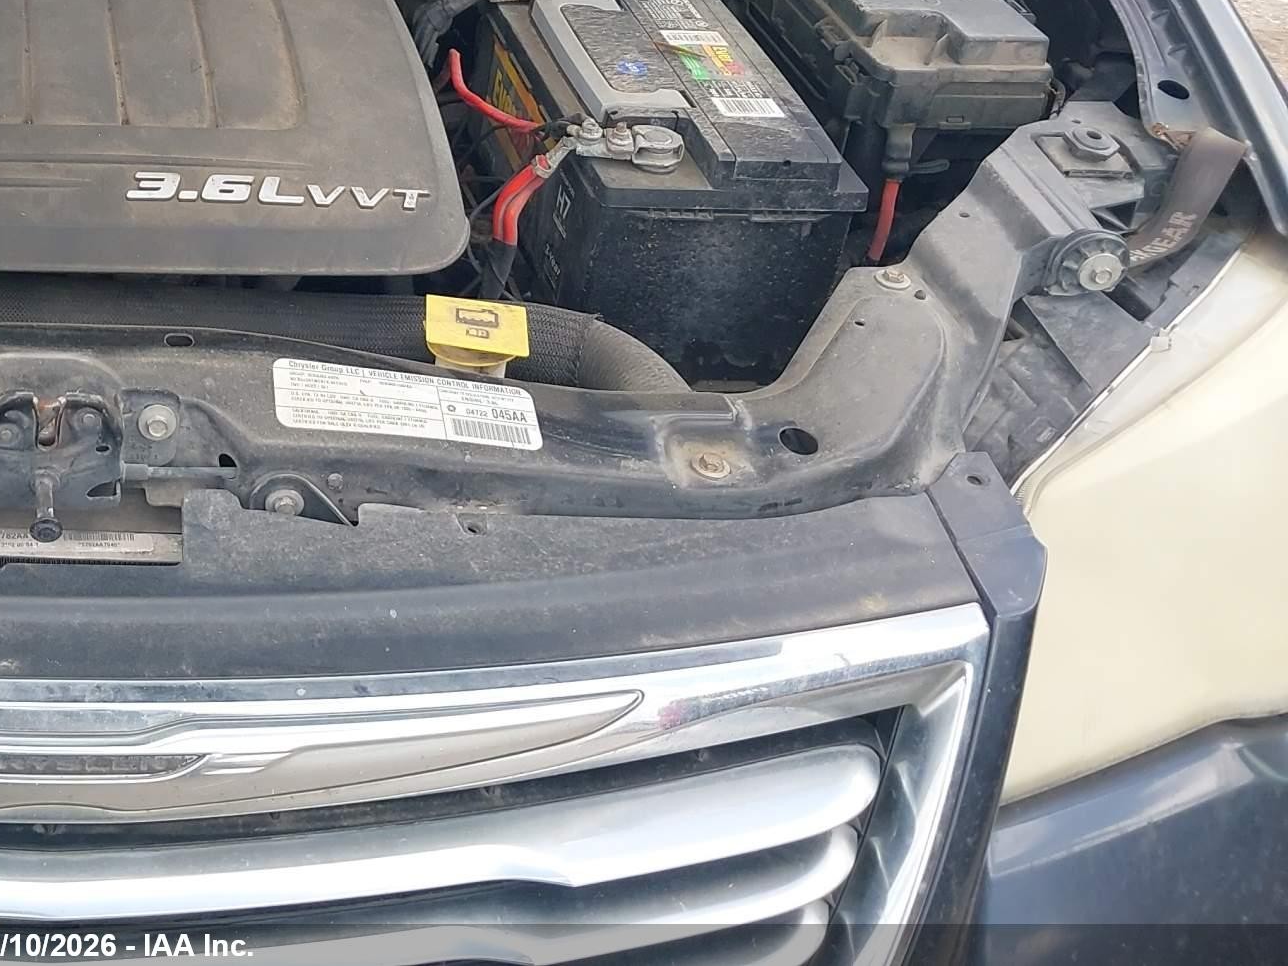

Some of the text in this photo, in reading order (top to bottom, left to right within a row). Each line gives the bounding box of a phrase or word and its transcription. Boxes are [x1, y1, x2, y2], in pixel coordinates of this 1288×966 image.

[125, 171, 431, 212] 3.6L VVT
[288, 360, 319, 370] Chrysler
[321, 364, 344, 374] Group
[346, 366, 360, 375] LLC
[368, 370, 398, 380] VEHICLE
[400, 373, 435, 384] EMISSION
[436, 379, 470, 389] CONTROL
[471, 383, 522, 396] INFORMATION
[491, 408, 528, 423] 045AA
